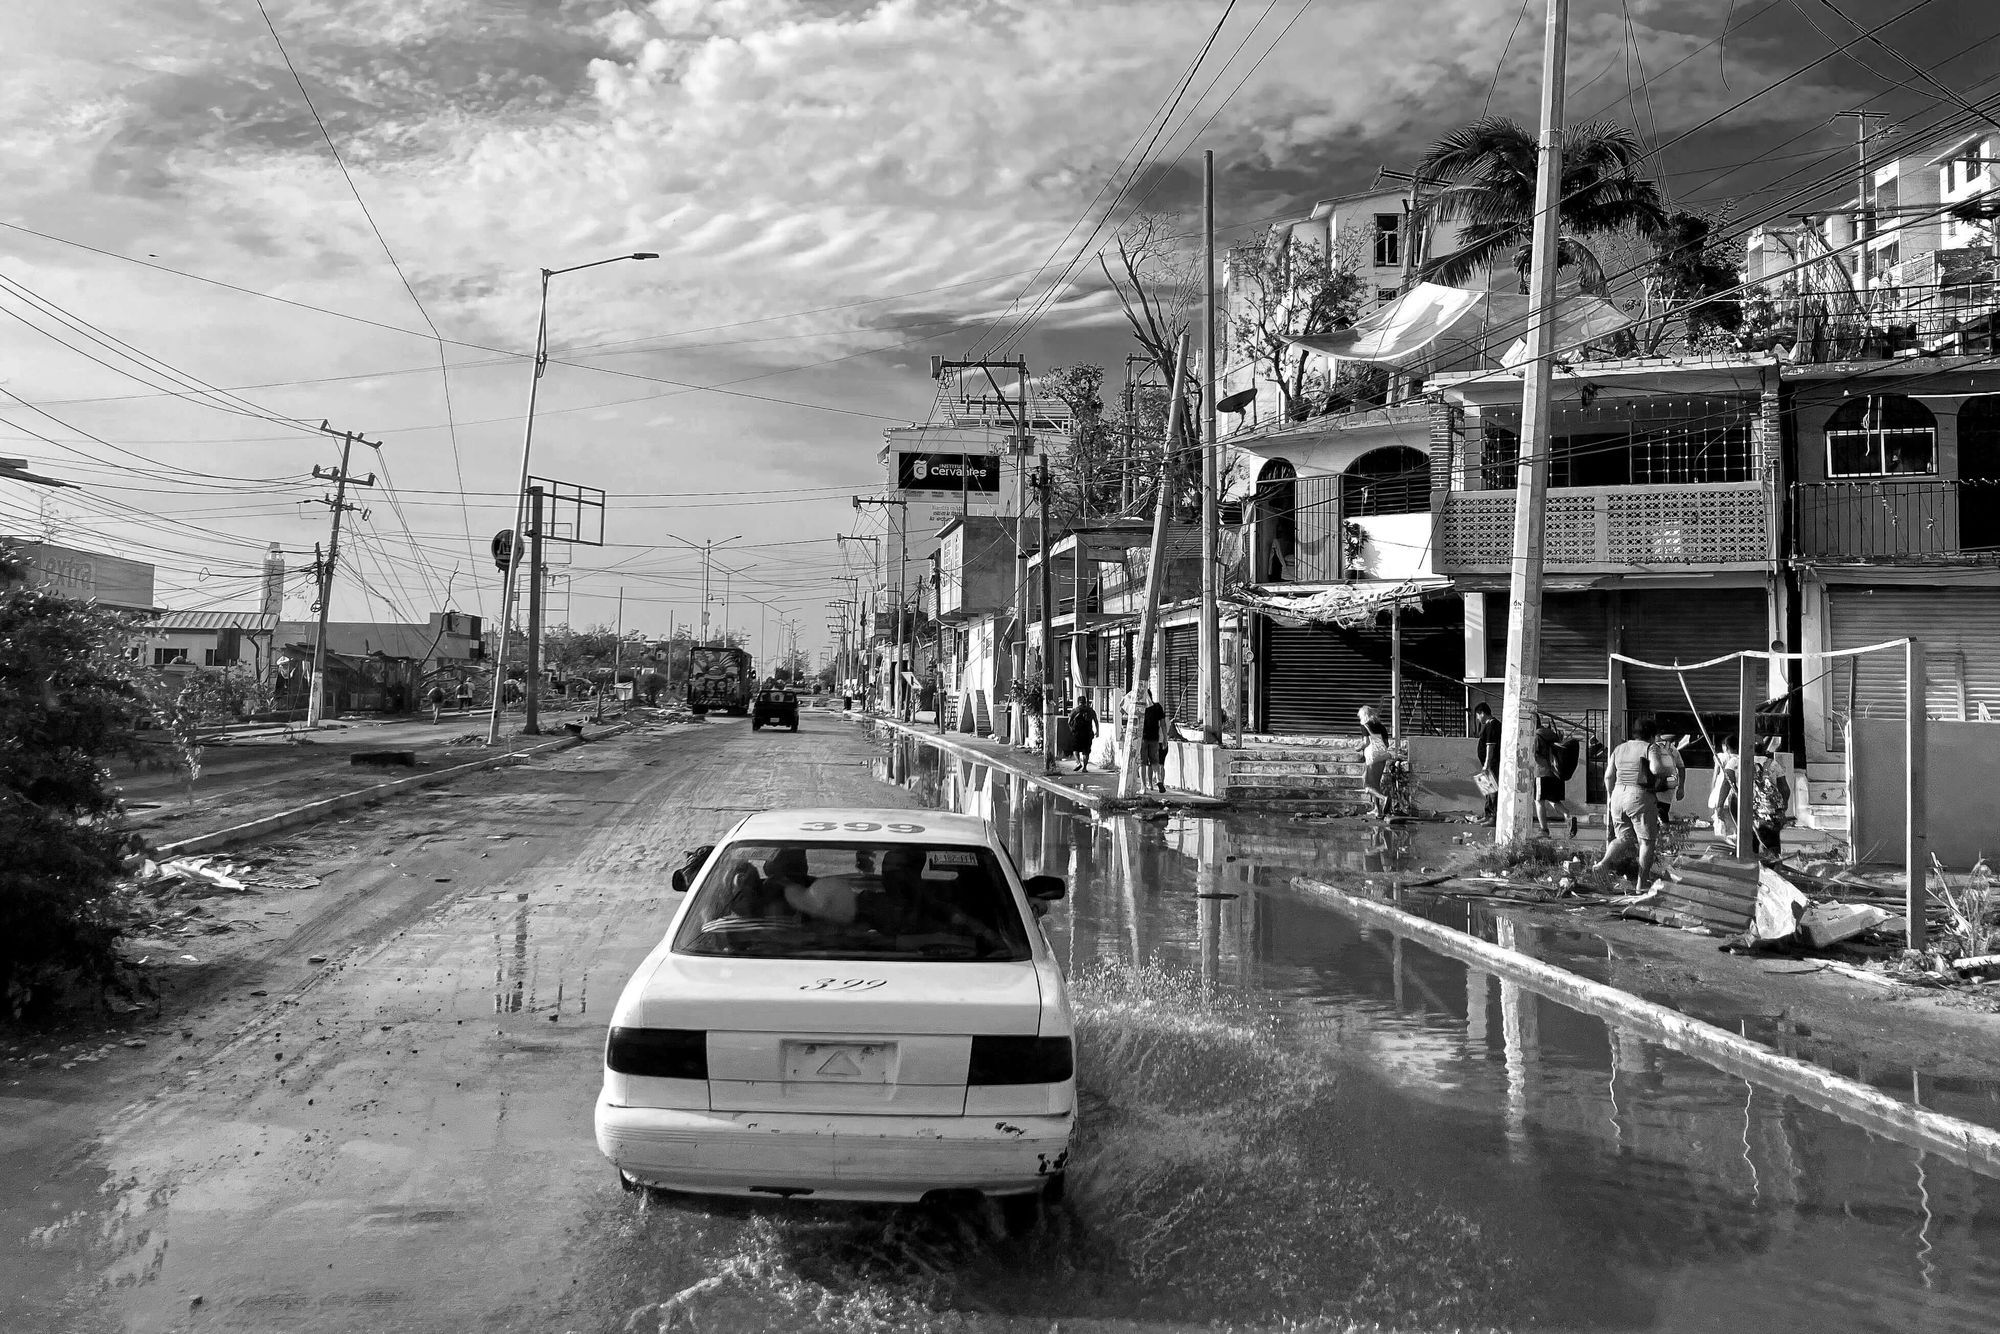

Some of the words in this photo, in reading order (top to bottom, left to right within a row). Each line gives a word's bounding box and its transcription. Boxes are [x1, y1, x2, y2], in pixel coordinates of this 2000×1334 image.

[45, 557, 92, 590] extra
[799, 821, 926, 834] 399
[799, 977, 888, 993] 399
